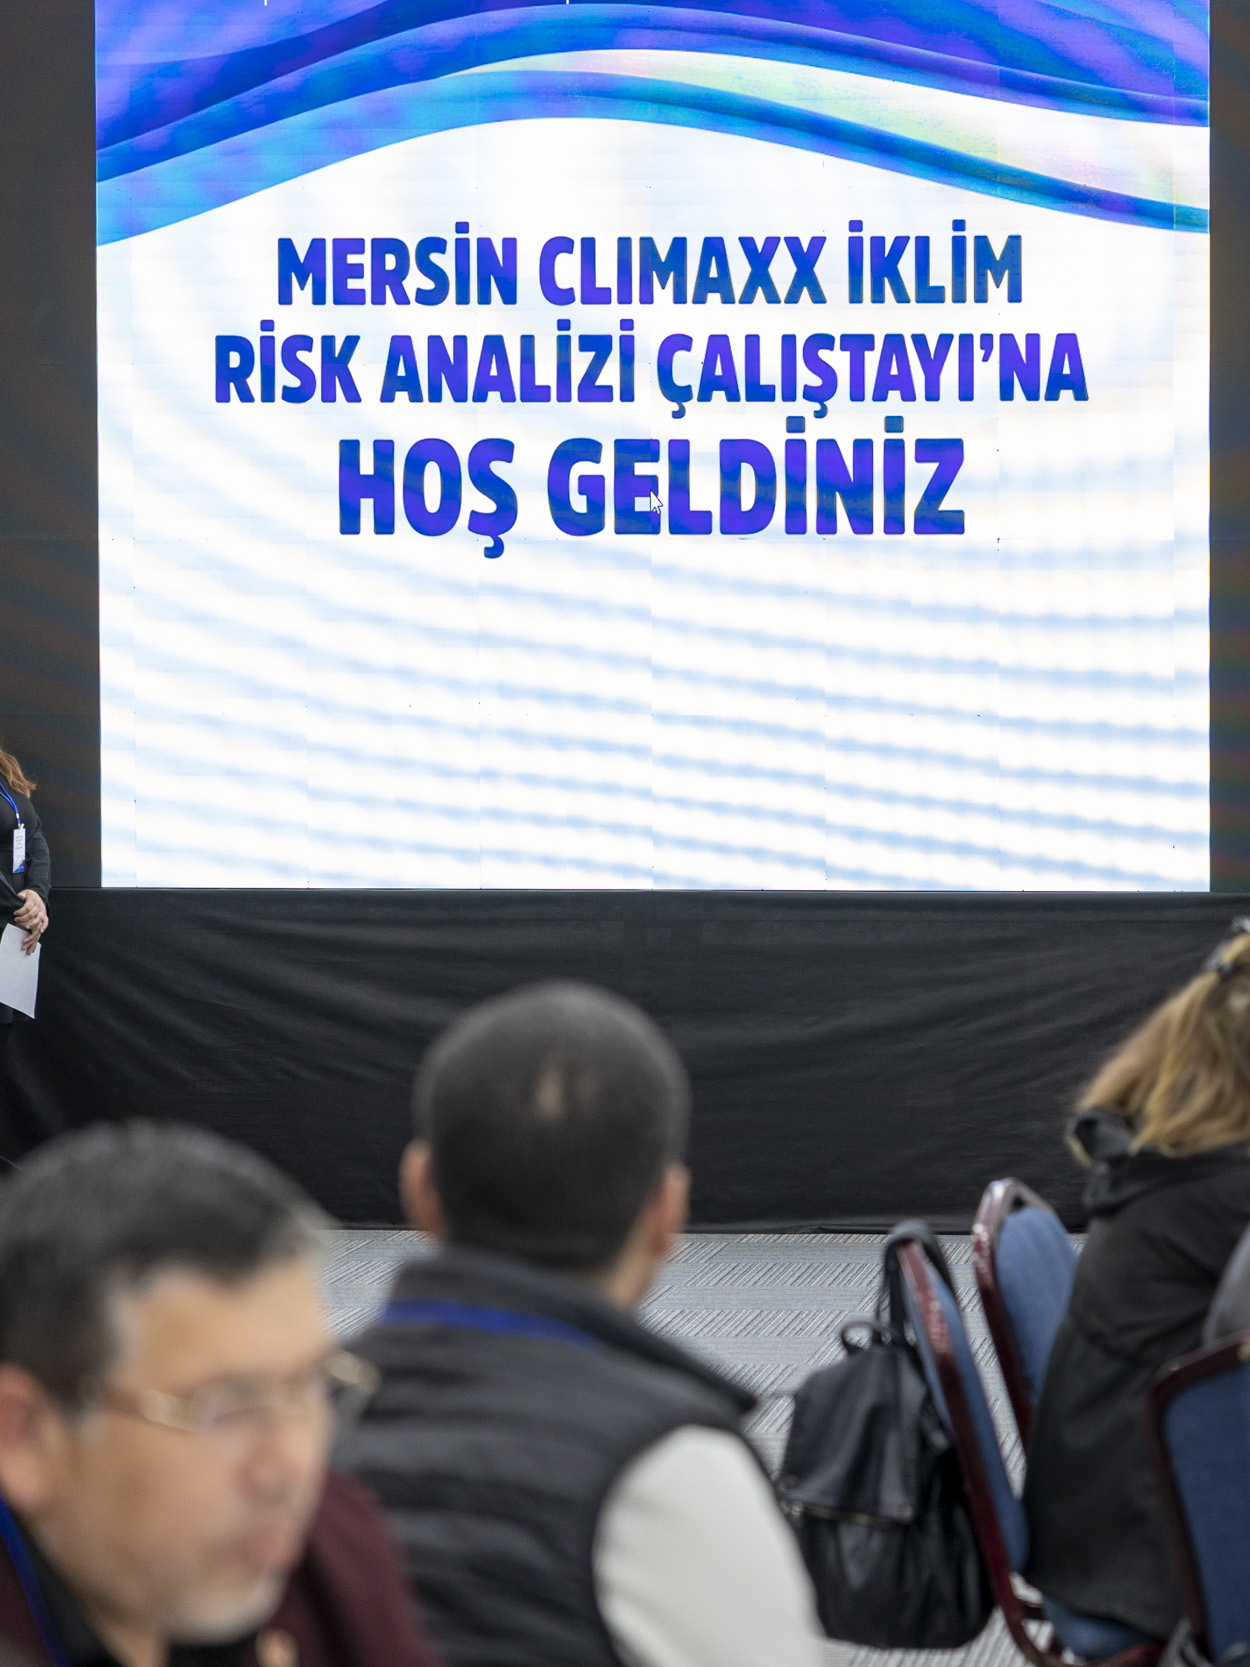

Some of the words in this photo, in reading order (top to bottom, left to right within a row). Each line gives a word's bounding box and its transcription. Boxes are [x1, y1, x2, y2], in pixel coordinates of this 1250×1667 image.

[277, 221, 517, 306] MERSİN
[539, 235, 827, 306] CLIMAXX
[847, 219, 1022, 304] İKLİM
[215, 319, 361, 404] RİSK
[379, 318, 635, 403] ANALİZİ
[338, 438, 518, 558] HOŞ
[547, 415, 966, 537] GELDİNİZ
